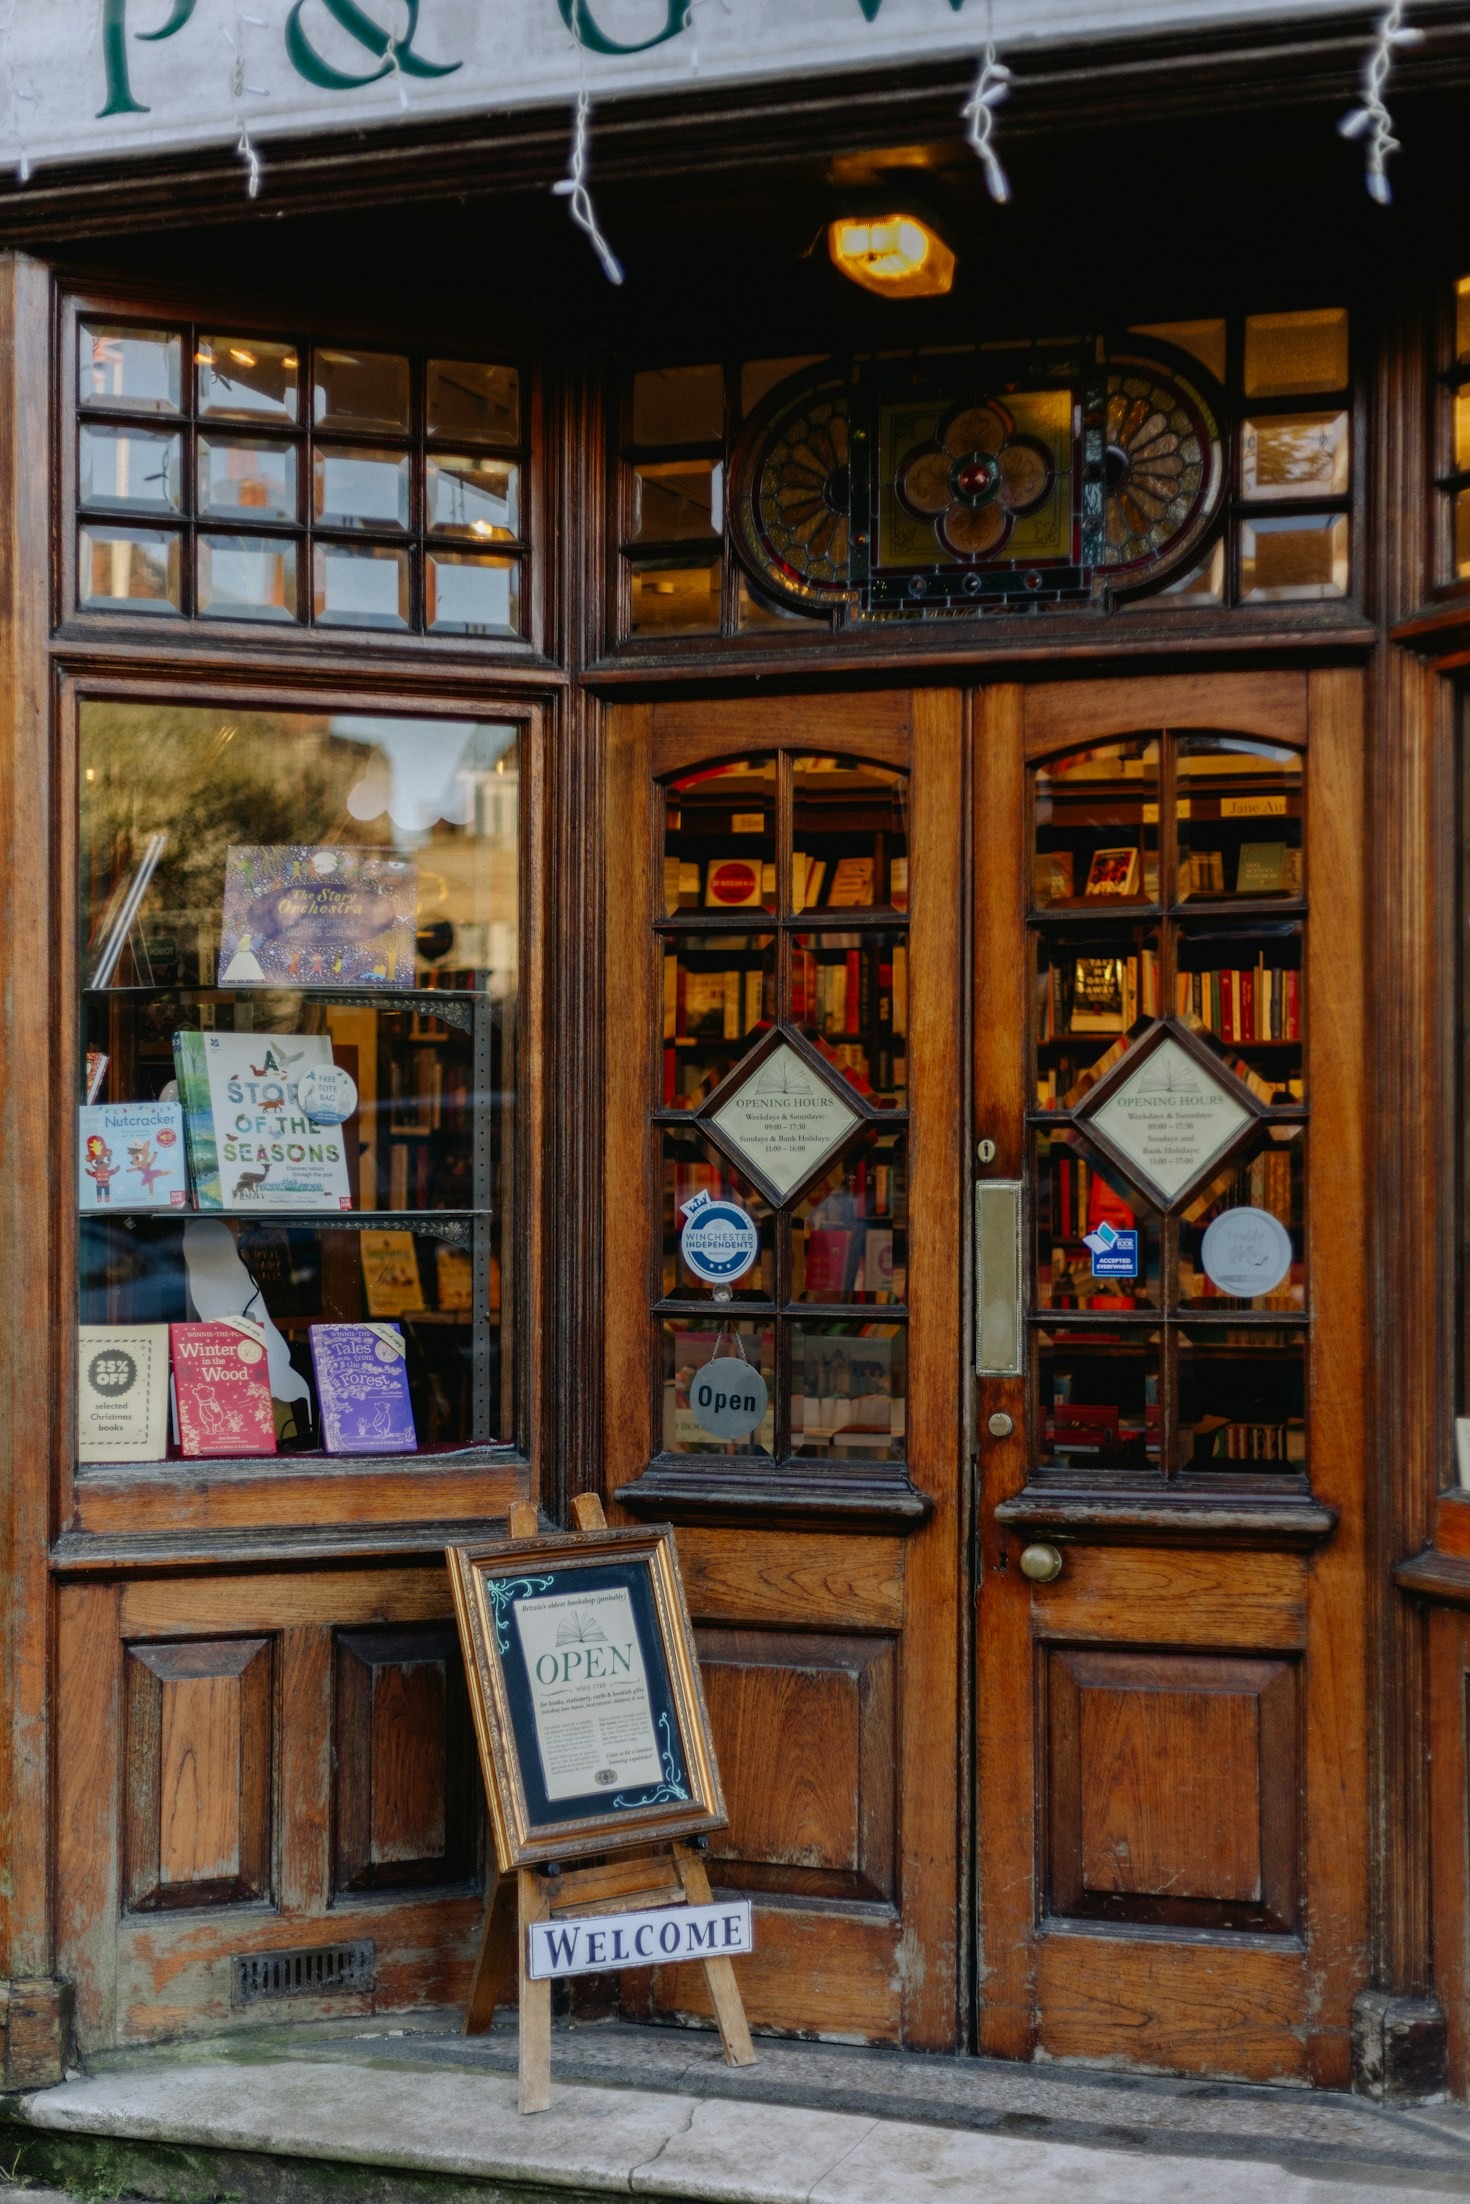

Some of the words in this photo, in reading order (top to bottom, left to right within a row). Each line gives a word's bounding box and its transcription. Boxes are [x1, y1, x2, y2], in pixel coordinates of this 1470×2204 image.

[1230, 802, 1260, 814] Jane
[292, 889, 314, 899] The
[318, 887, 357, 903] Story
[278, 899, 363, 914] Orchestra
[300, 918, 355, 926] MIDSUMMER
[283, 928, 322, 937] NIGHT'S
[325, 928, 359, 937] DREAM
[263, 1050, 279, 1071] A
[319, 1075, 337, 1083] FREE
[227, 1082, 299, 1104] STOR
[319, 1094, 336, 1102] BAG
[736, 1099, 791, 1108] OPENING
[794, 1097, 834, 1107] HOURS
[1117, 1097, 1177, 1107] OPENING
[1180, 1095, 1224, 1106] HOURS
[105, 1112, 175, 1128] Nutcracker
[790, 1113, 825, 1121] Saturdays:
[1128, 1113, 1164, 1121] Weekdays
[1175, 1112, 1214, 1121] Saturdays:
[235, 1116, 267, 1134] OF
[275, 1116, 321, 1134] THE
[739, 1135, 768, 1143] Sundays
[798, 1135, 831, 1143] Holidays:
[1147, 1135, 1179, 1144] Sundays
[223, 1143, 340, 1163] SEASONS
[685, 1233, 754, 1241] WINCHESTER
[685, 1241, 754, 1249] INDEPENDENTS
[178, 1343, 237, 1358] Winter
[331, 1341, 371, 1356] Tales
[96, 1361, 129, 1373] 25%
[96, 1373, 129, 1386] OFF
[201, 1367, 249, 1382] Wood
[340, 1374, 391, 1387] Forest
[698, 1385, 756, 1414] Open
[95, 1402, 128, 1410] selected
[90, 1412, 132, 1421] Christmas
[98, 1424, 124, 1432] books
[522, 1602, 547, 1612] Britain's
[567, 1597, 596, 1607] bookshop
[597, 1593, 627, 1604] (probably)
[536, 1643, 633, 1685] OPEN
[566, 1695, 592, 1704] stationery,
